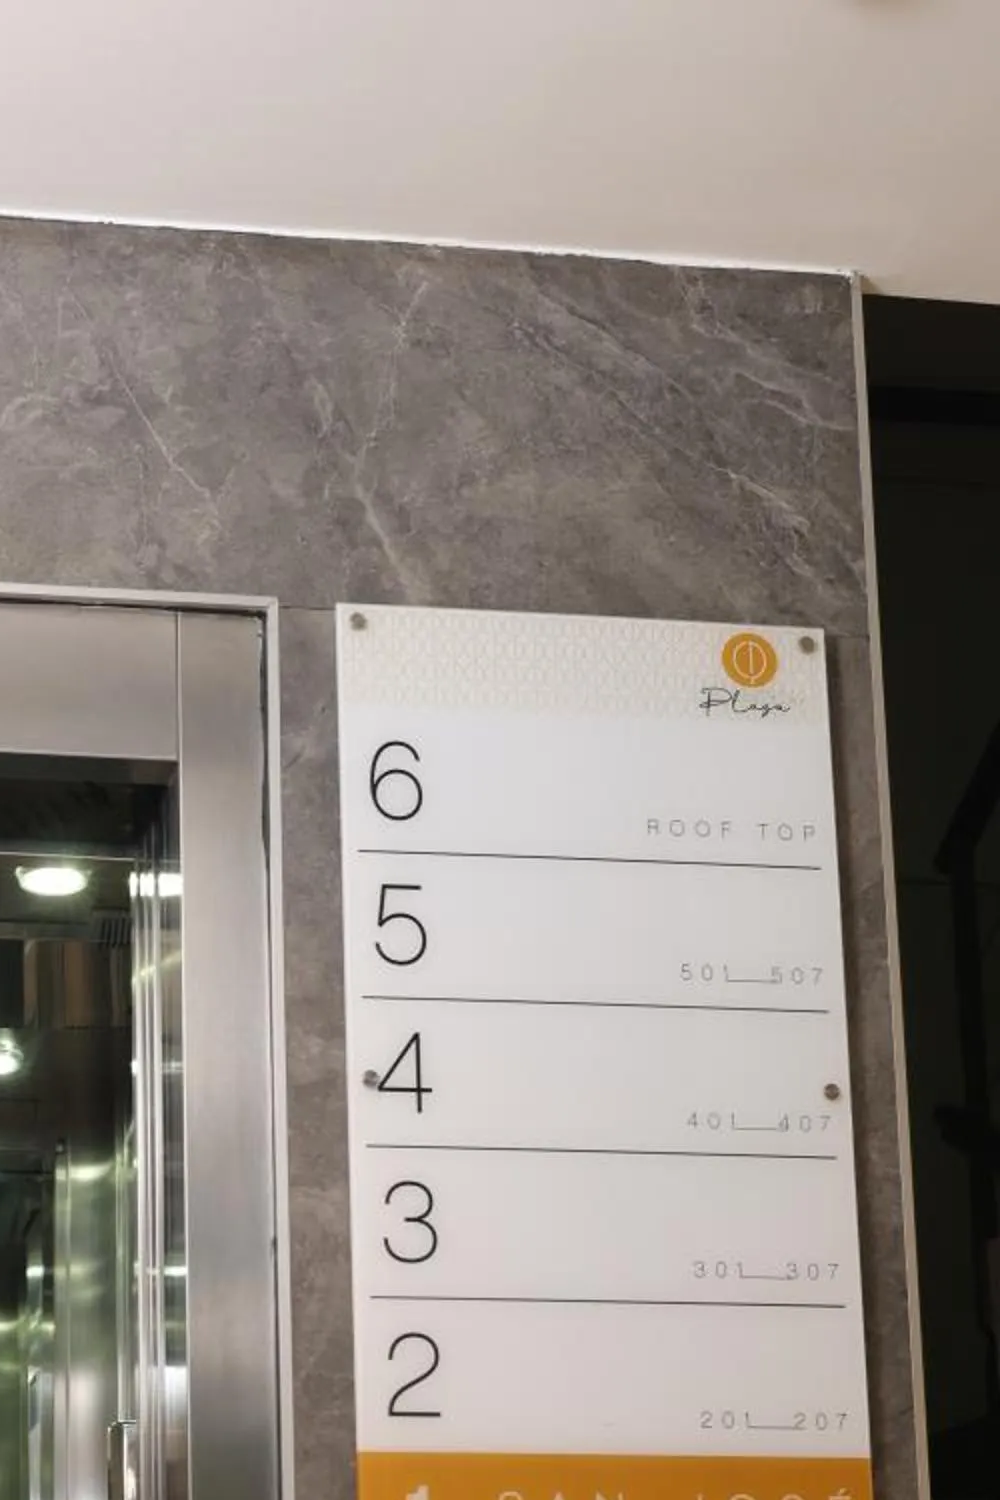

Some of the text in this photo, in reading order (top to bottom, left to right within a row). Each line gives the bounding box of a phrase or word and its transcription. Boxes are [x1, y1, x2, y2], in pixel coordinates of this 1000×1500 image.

[368, 739, 424, 822] 6
[646, 818, 816, 842] ROOF TOP
[374, 882, 428, 967] 5
[376, 1031, 434, 1115] 4
[383, 1179, 439, 1265] 3
[387, 1331, 443, 1419] 2
